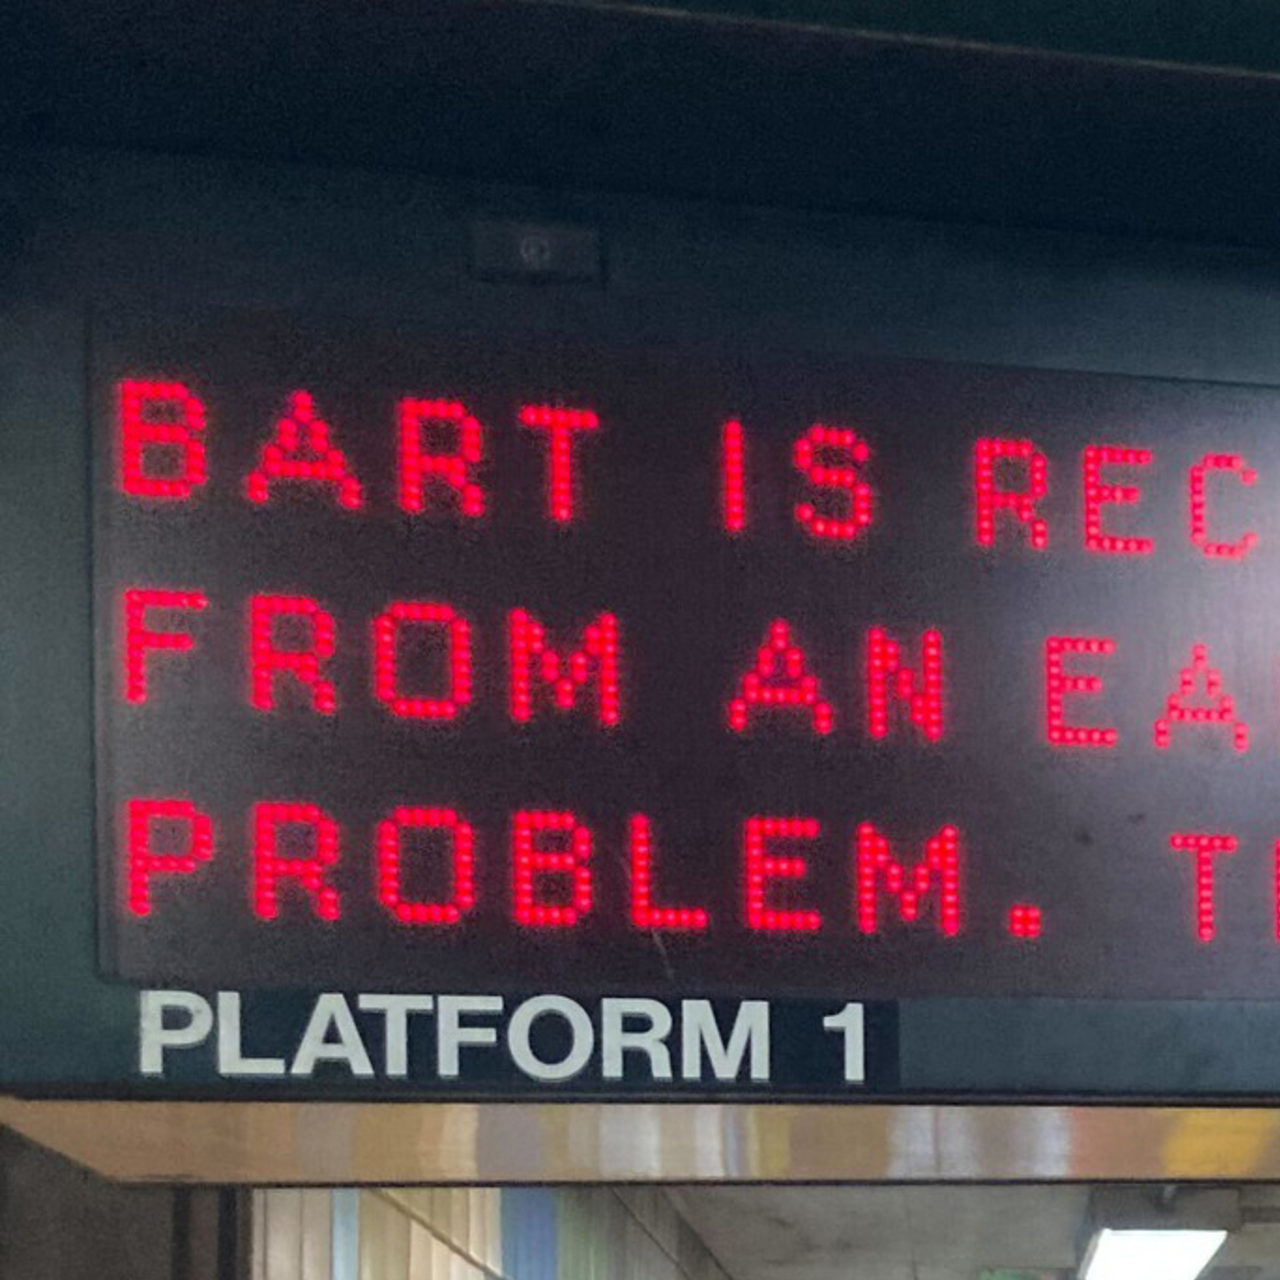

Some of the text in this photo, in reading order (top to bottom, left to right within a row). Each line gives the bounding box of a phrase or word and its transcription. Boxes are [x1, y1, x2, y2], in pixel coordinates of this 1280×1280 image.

[118, 379, 599, 523] BART
[722, 419, 873, 541] IS
[123, 588, 620, 727] FROM
[728, 618, 942, 742] AN
[126, 799, 1042, 939] PROBLEM.
[138, 990, 867, 1083] PLATFORM 1
